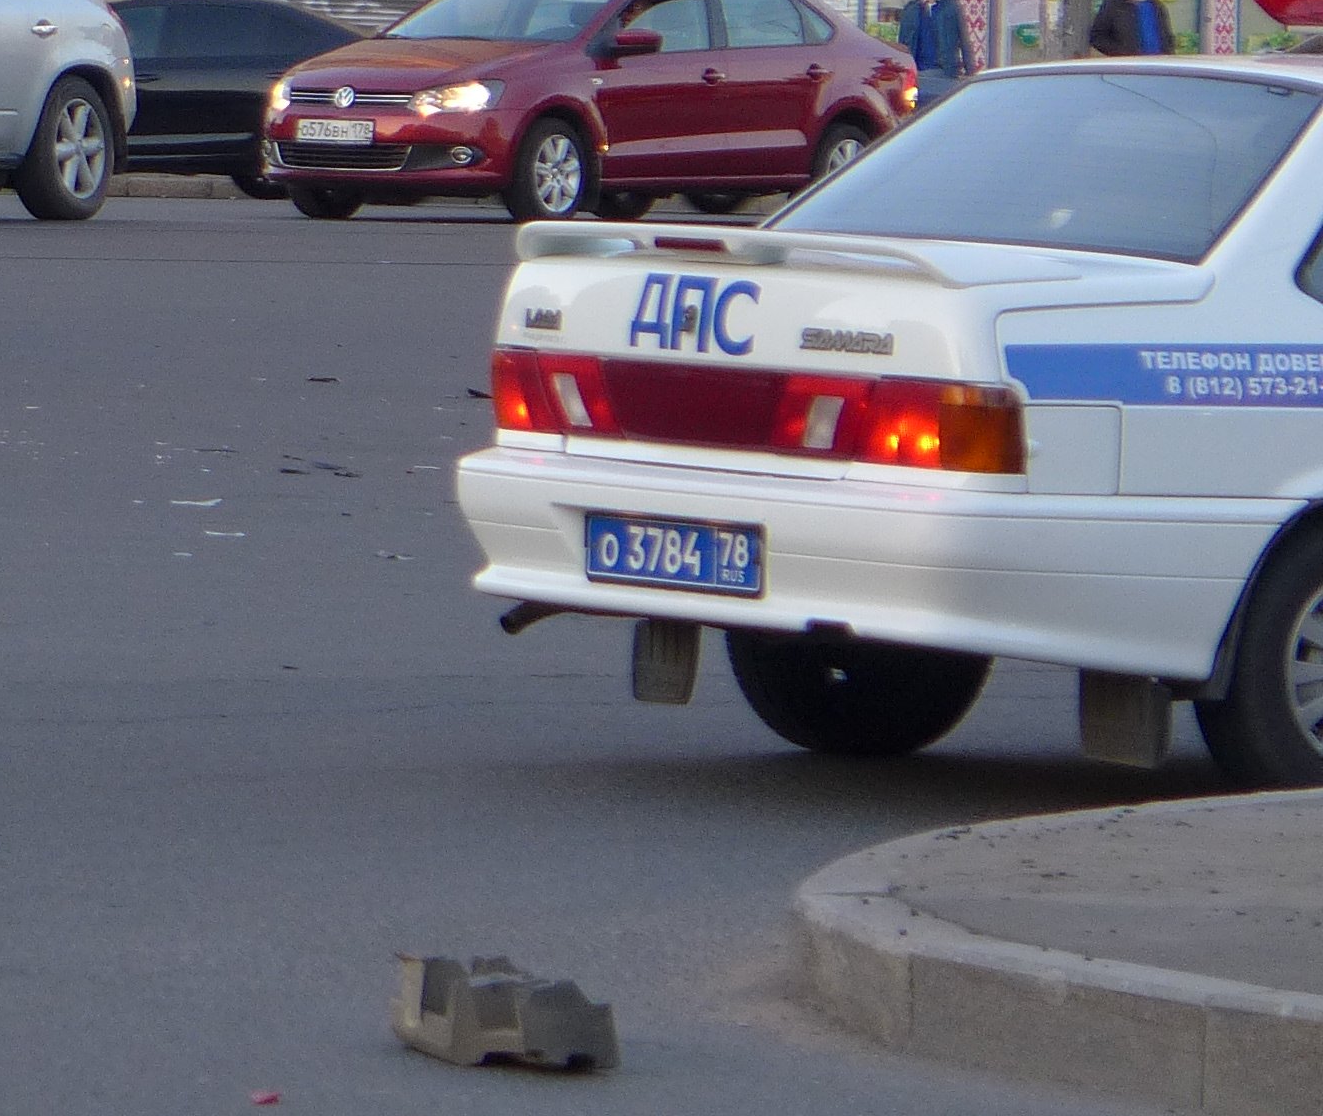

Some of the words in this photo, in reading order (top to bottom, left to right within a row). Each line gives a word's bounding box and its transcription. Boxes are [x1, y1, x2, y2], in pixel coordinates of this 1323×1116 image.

[351, 122, 370, 135] 178
[630, 273, 762, 356] ДПС
[1140, 351, 1252, 370] ТЕЛЕФОН
[1258, 353, 1323, 375] ДОВЕ
[1167, 376, 1182, 394] 8
[1188, 377, 1243, 400] (812)
[627, 525, 701, 576] 3784
[717, 532, 750, 568] 78
[721, 569, 746, 584] RUS
